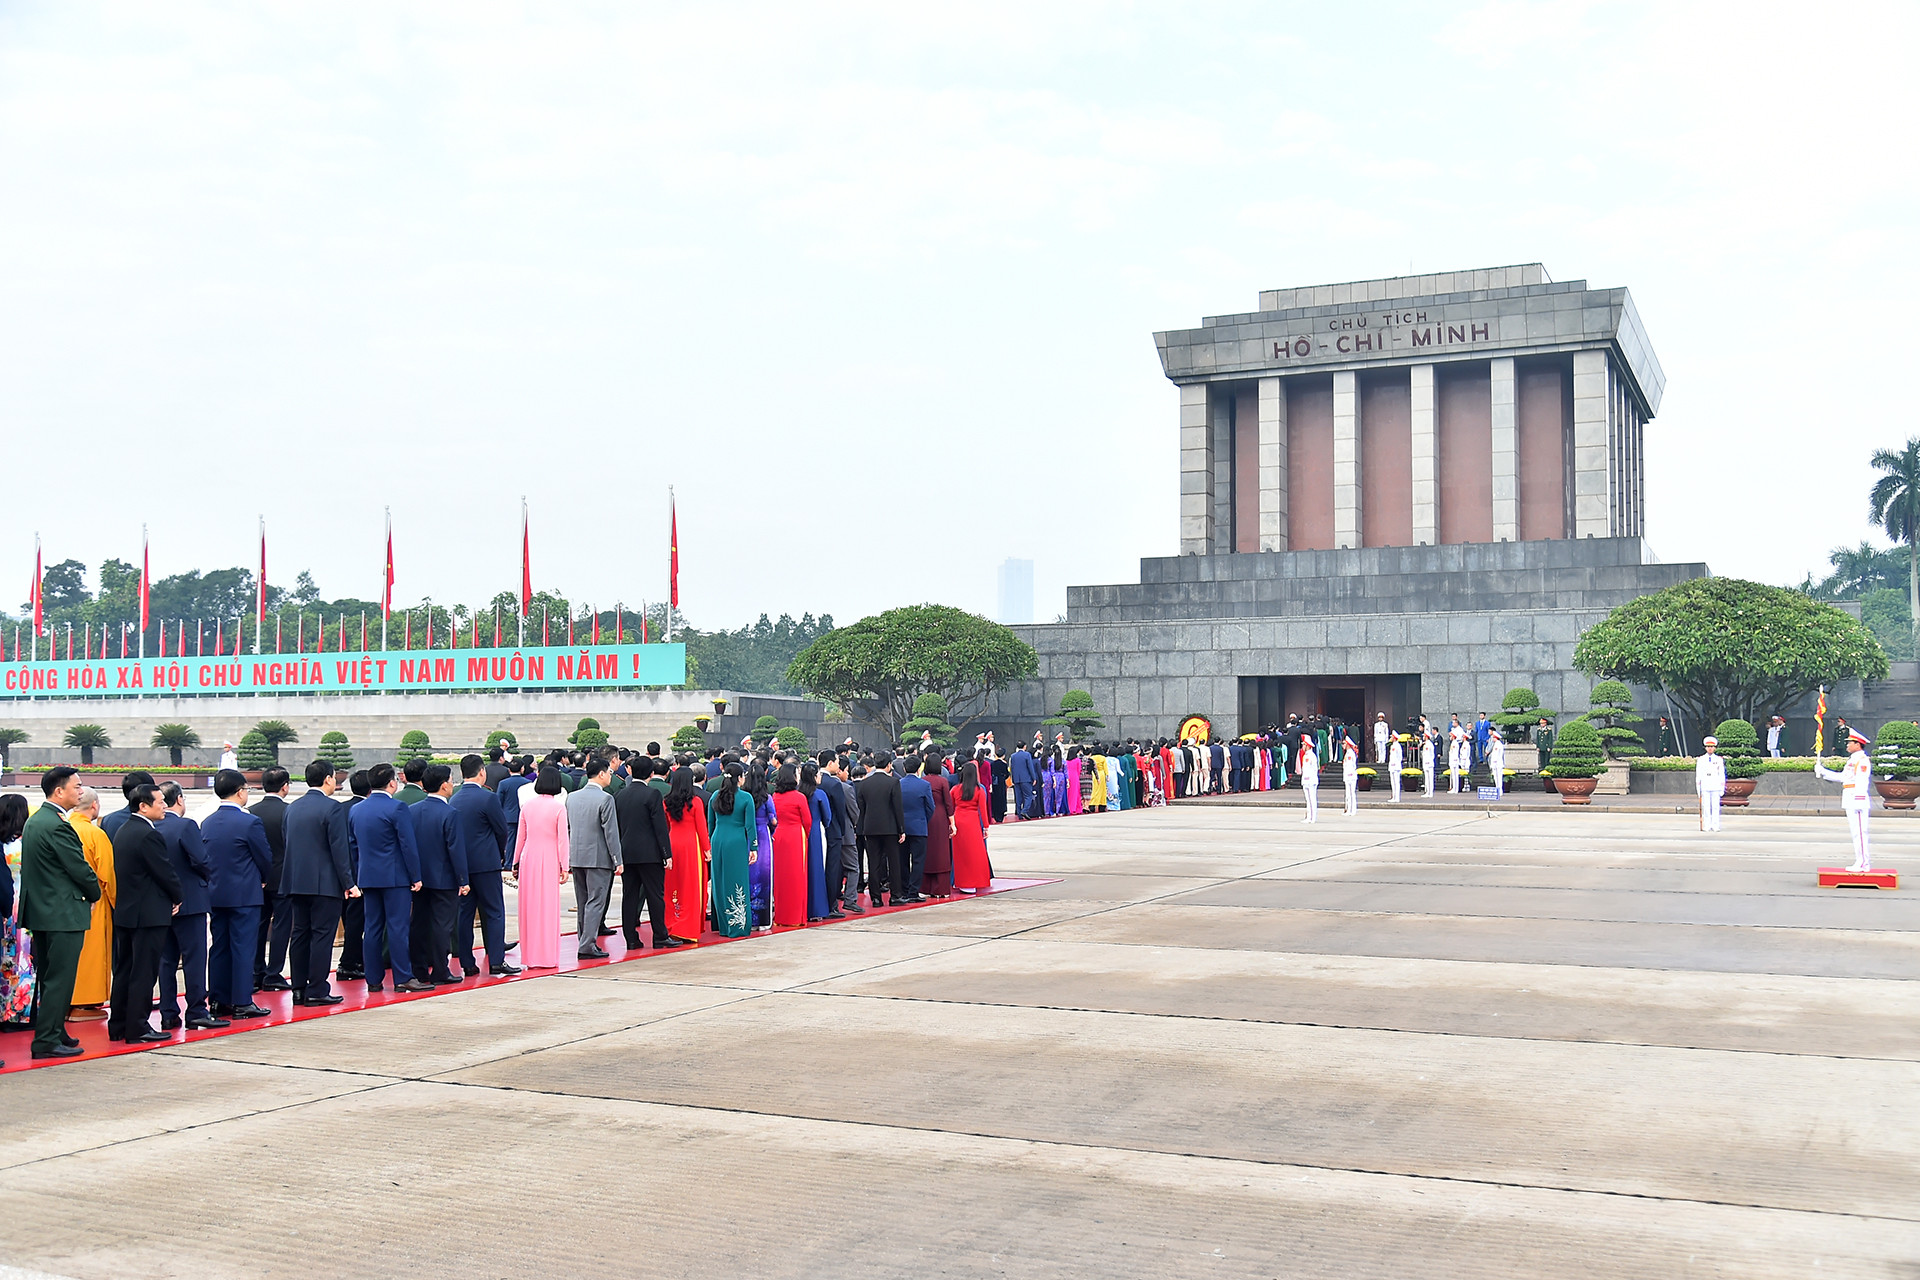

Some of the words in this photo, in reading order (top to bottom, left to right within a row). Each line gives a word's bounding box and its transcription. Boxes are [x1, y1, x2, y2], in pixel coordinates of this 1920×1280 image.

[1329, 313, 1367, 331] CHỦ
[1382, 310, 1427, 329] TỊCH
[1273, 334, 1311, 359] HỒ
[1336, 326, 1384, 353] CHÍ
[1411, 322, 1489, 347] MINH
[5, 664, 58, 694] CỘNG
[67, 663, 108, 690] HÒA
[117, 662, 144, 689] XÃ
[153, 660, 189, 692] HỘI
[199, 656, 243, 688] CHỦ
[252, 658, 324, 687] NGHĨA
[336, 655, 388, 689] VIỆT
[399, 658, 455, 684] NAM
[467, 651, 545, 683] MUÔN
[557, 649, 618, 682] NĂM
